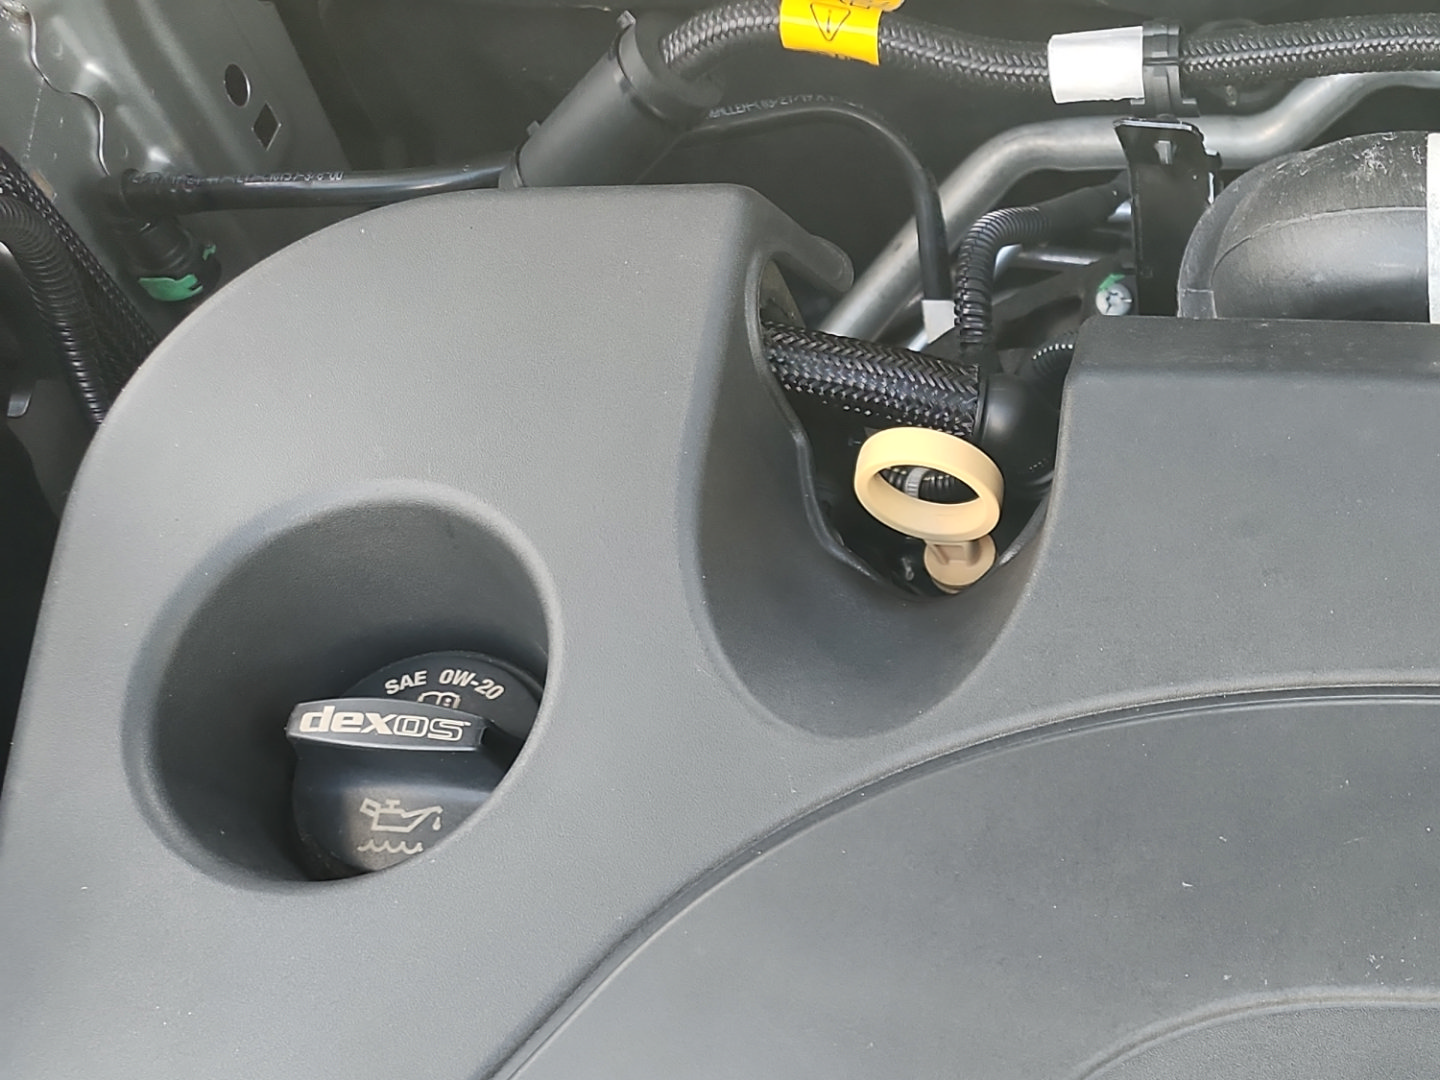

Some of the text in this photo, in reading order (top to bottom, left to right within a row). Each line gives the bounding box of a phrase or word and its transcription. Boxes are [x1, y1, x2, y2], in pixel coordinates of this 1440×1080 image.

[385, 668, 505, 701] SAE 0W-20
[299, 705, 472, 742] dexos
